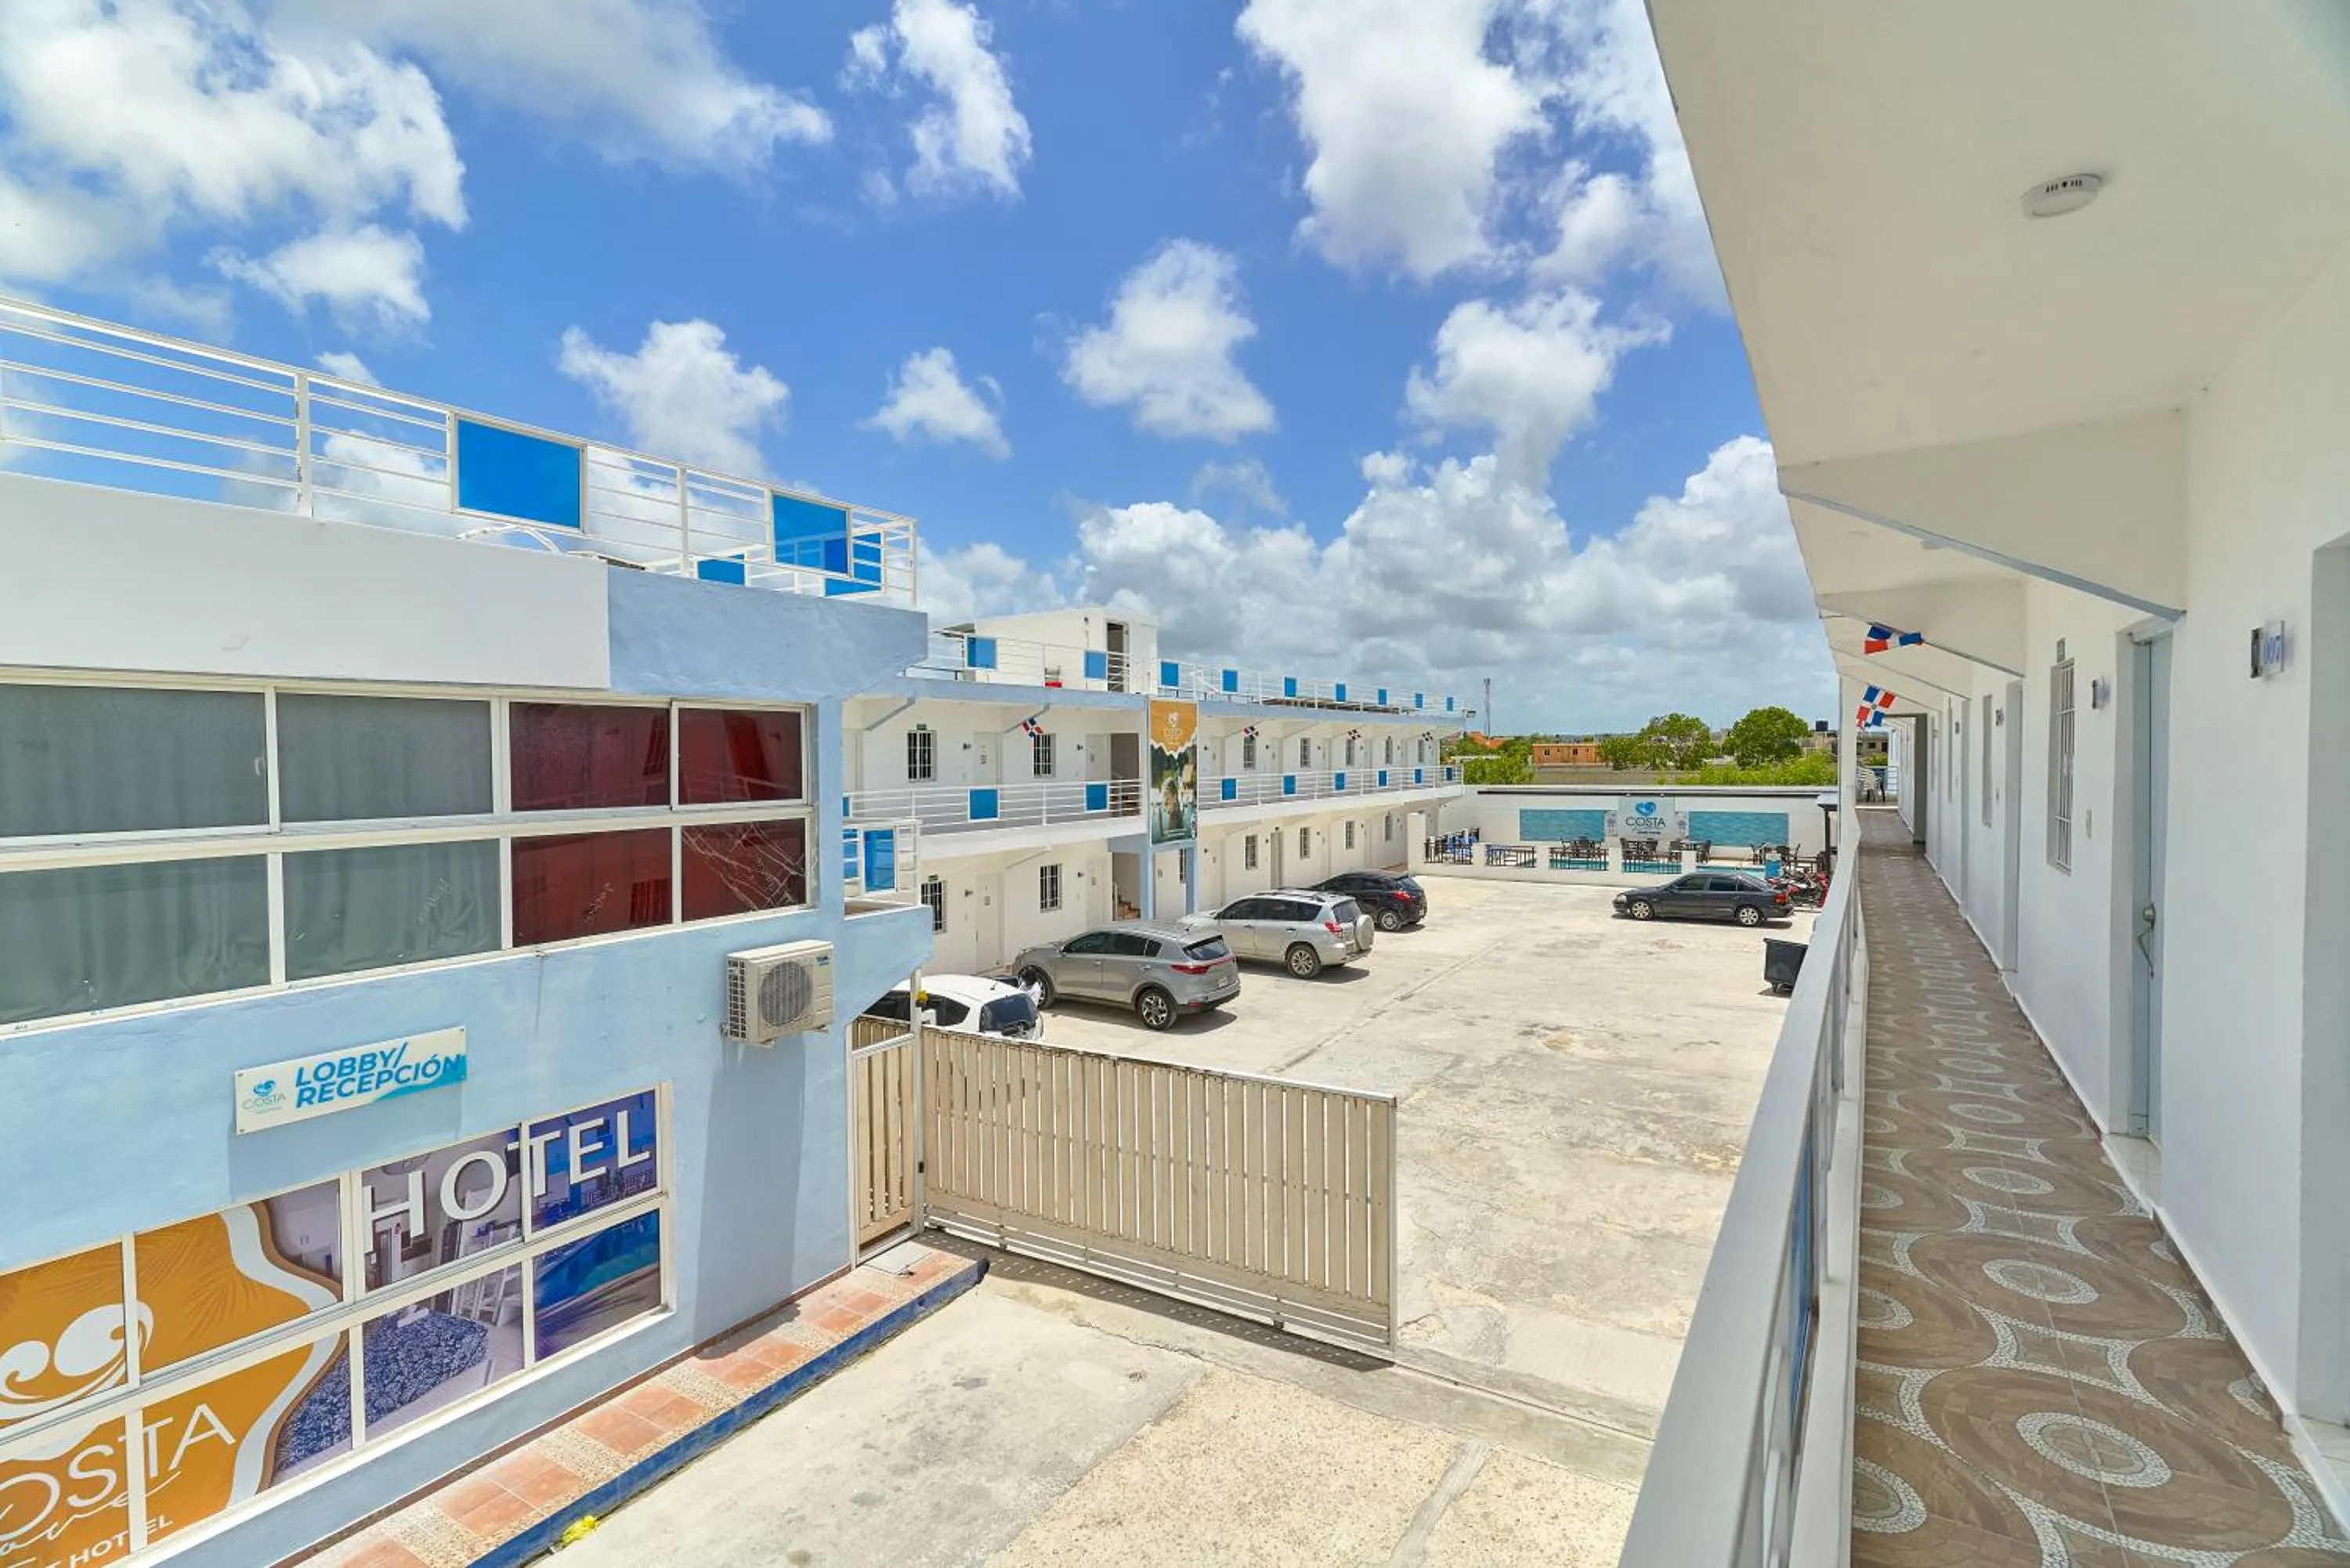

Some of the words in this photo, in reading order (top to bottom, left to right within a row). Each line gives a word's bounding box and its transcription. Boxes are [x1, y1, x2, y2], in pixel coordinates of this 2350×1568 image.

[1625, 817, 1666, 828] COSTA
[295, 1041, 408, 1088] LOBBY/
[295, 1053, 464, 1109] RECEPCIÓN
[363, 1110, 653, 1254] HOTEL
[0, 1403, 236, 1543] OSTA
[69, 1515, 174, 1568] HOTEL
